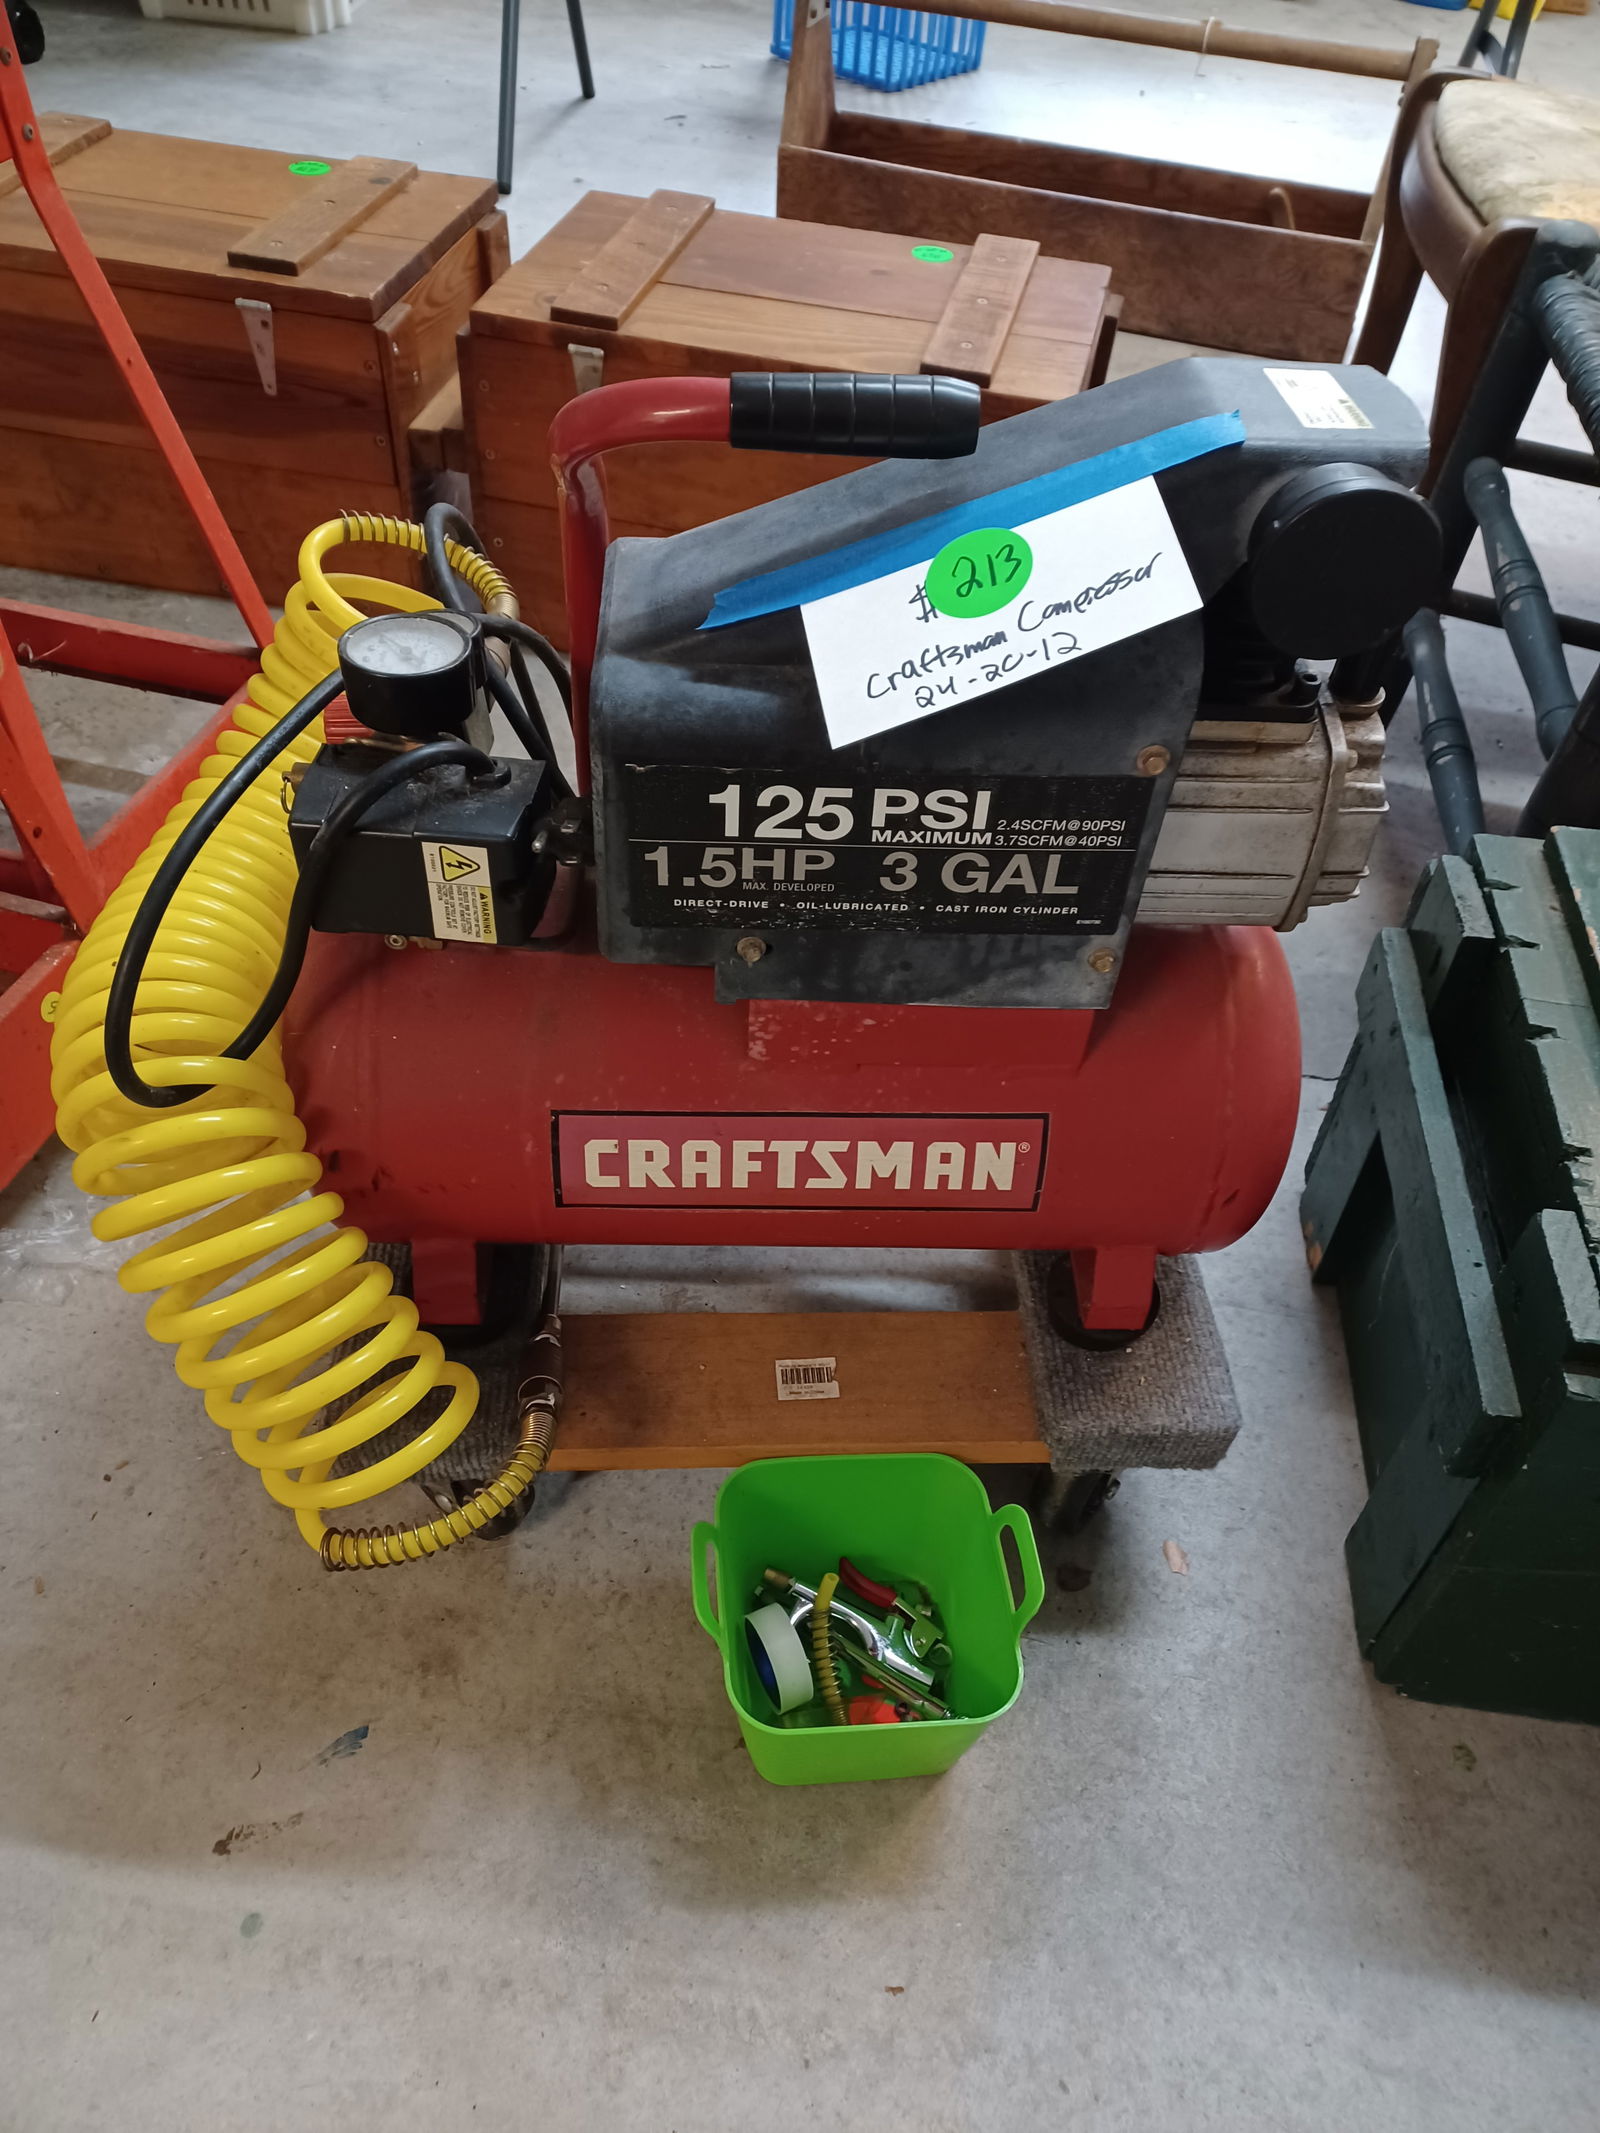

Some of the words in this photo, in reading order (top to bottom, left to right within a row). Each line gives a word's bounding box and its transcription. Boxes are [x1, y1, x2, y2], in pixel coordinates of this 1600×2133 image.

[951, 543, 1023, 598] 213
[867, 630, 1008, 699] Craftsman
[708, 784, 854, 840] 125
[871, 788, 992, 830] PSI
[996, 819, 1126, 832] 2.4SCFM@90PSI
[871, 830, 992, 846] MAXIMUM
[994, 835, 1123, 847] 3.7SCFM@40PSI
[773, 882, 836, 893] DEVELOPED
[879, 851, 919, 892] 3
[940, 852, 1080, 894] GAL
[480, 901, 492, 935] WARNING
[673, 898, 770, 909] DIRECT-DRIVE
[796, 901, 909, 912] OIL-LUBRICATED
[935, 904, 971, 914] CAST
[975, 905, 1008, 915] IRON
[1012, 905, 1079, 916] CYLINDER
[583, 1138, 1017, 1192] CRAFTSMAN
